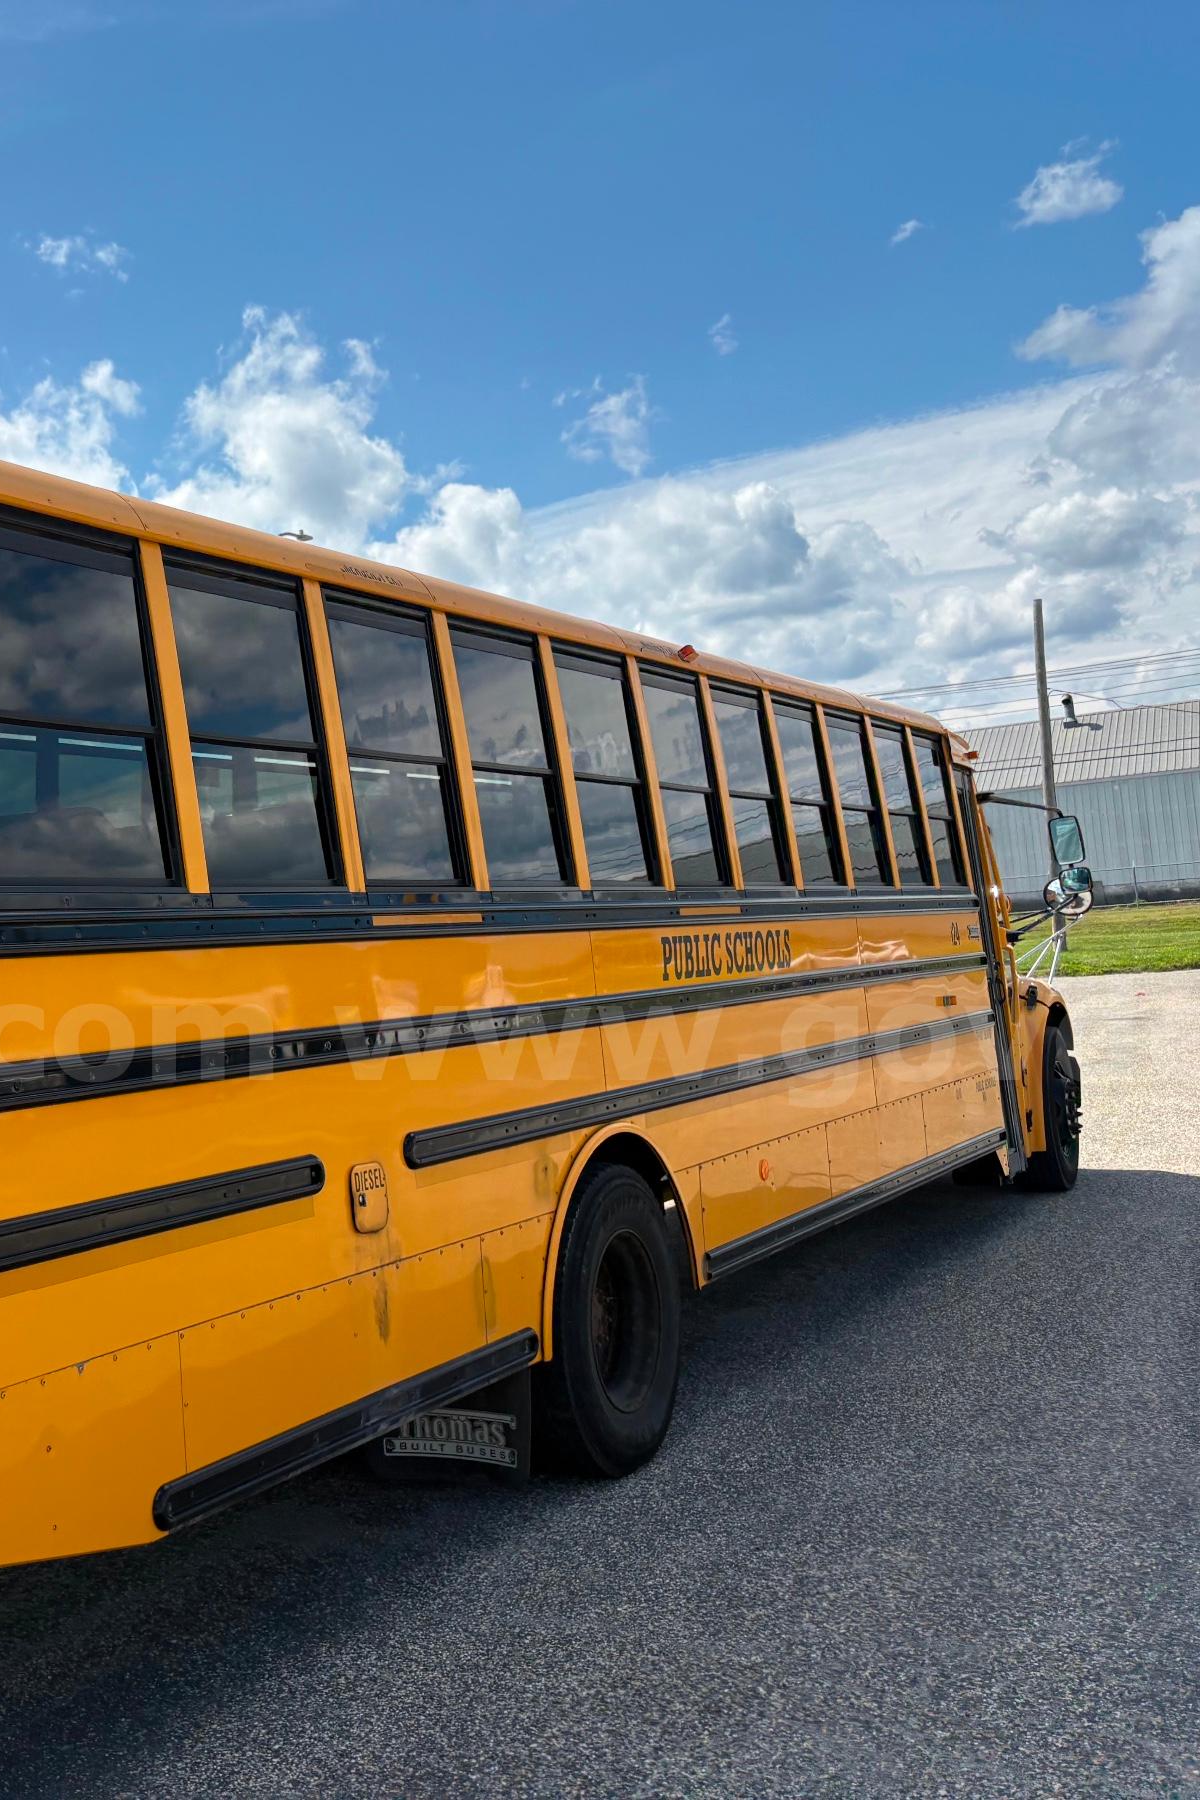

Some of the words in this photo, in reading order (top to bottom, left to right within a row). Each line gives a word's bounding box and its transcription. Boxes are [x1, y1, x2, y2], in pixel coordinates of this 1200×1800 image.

[660, 932, 722, 981] PUBLIC
[725, 928, 791, 974] SCHOOLS
[354, 1168, 385, 1193] DIESEL
[400, 1408, 517, 1448] Thomas
[399, 1440, 446, 1452] BUILT
[455, 1445, 506, 1461] BUSES
